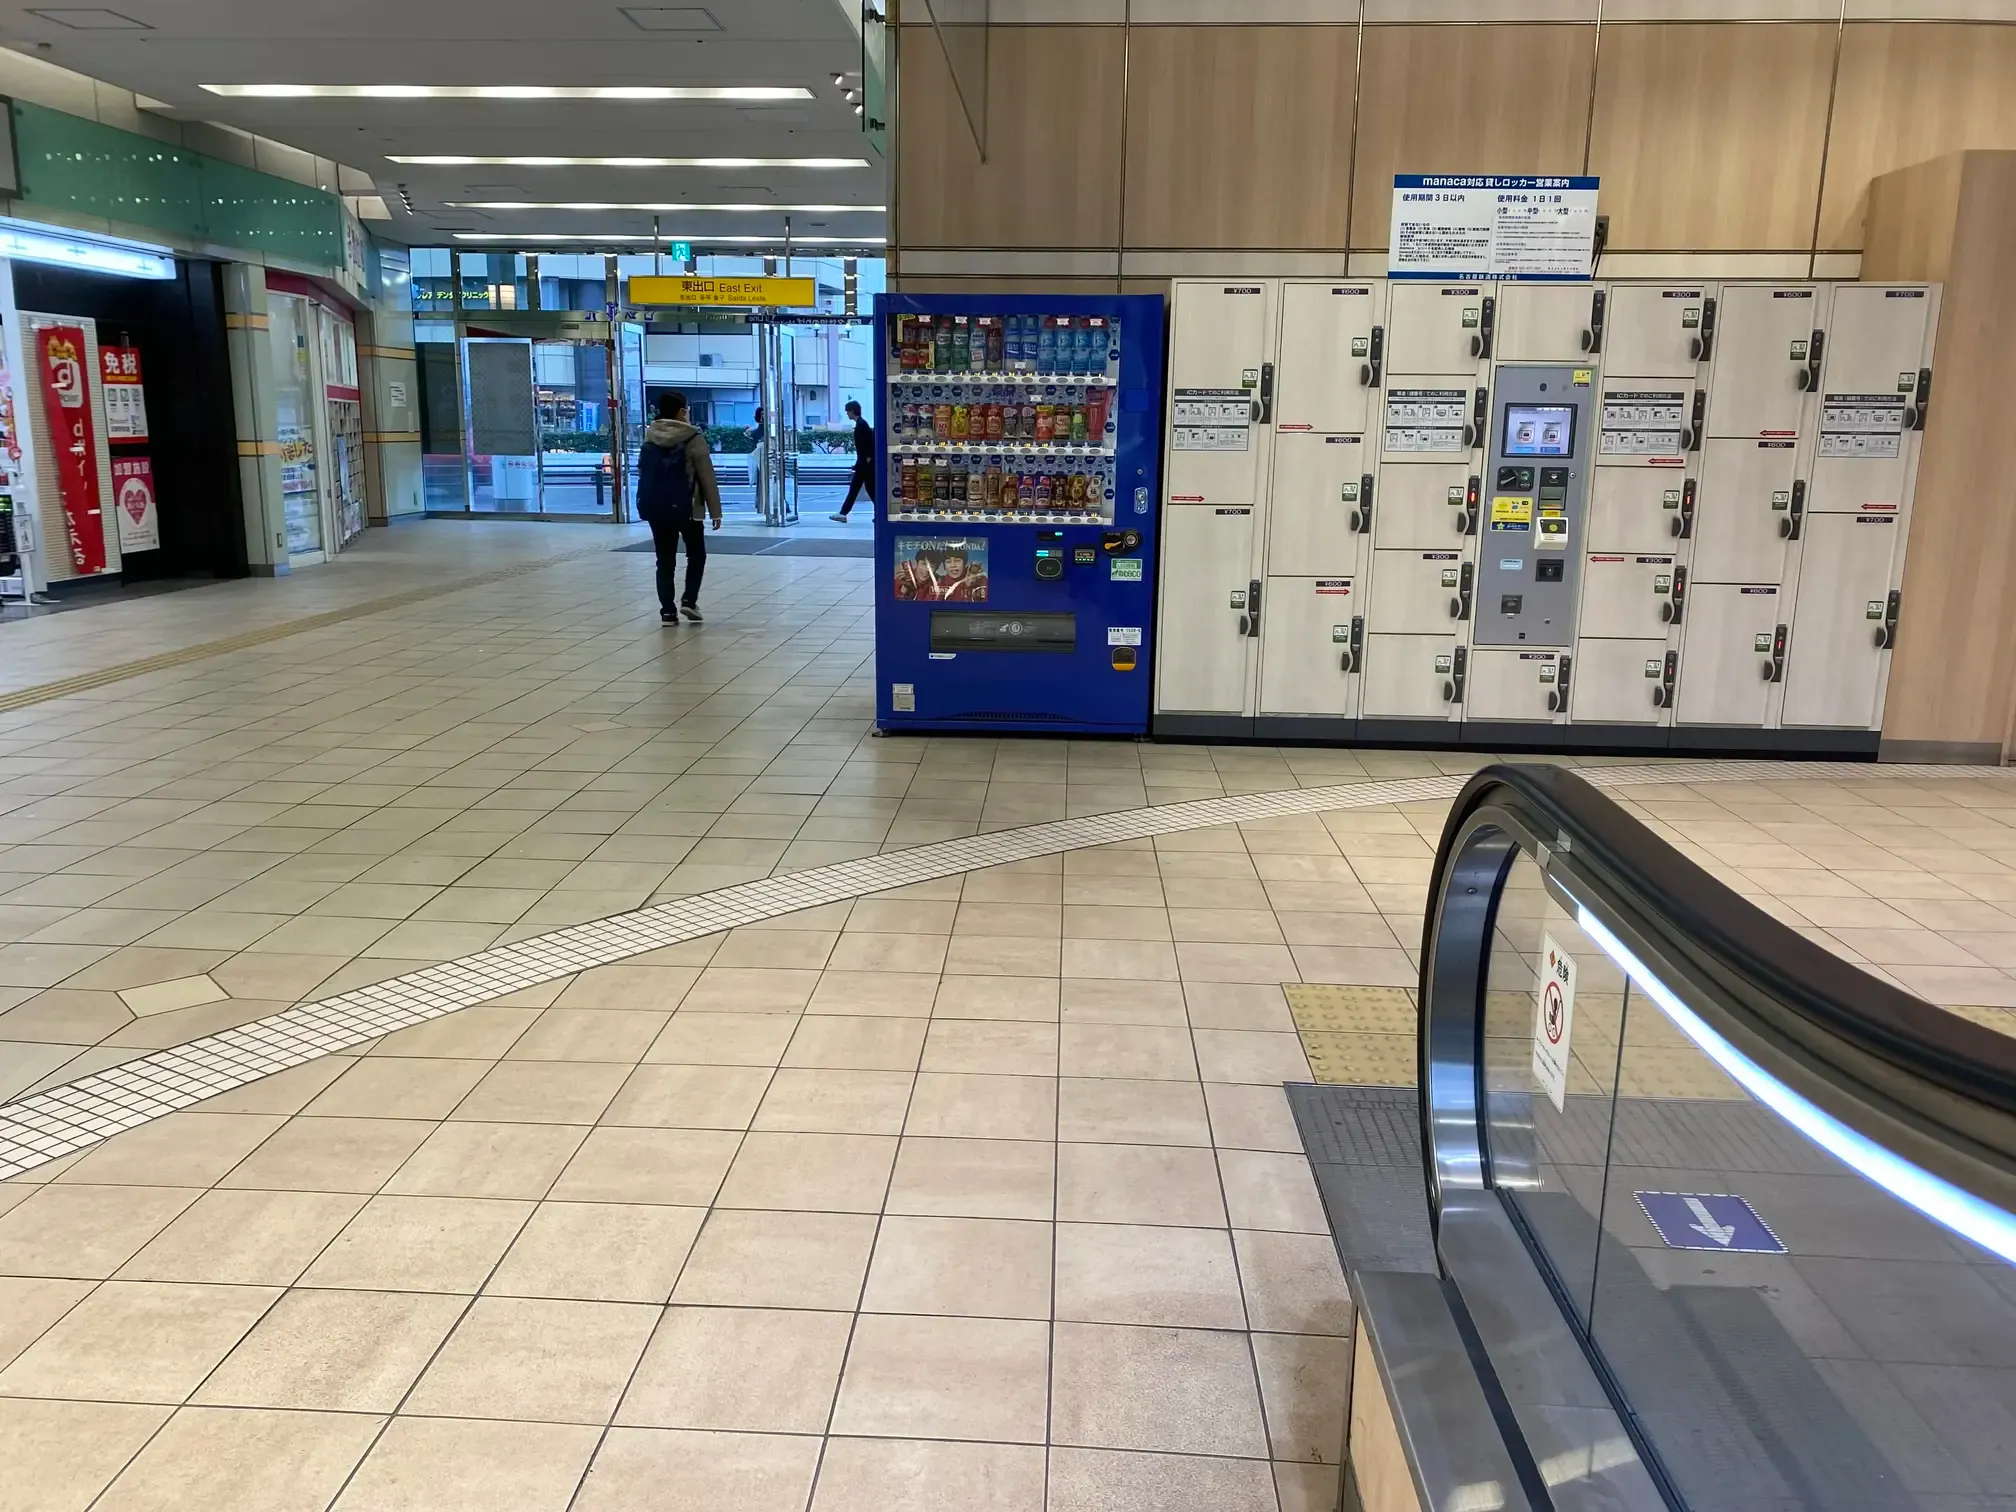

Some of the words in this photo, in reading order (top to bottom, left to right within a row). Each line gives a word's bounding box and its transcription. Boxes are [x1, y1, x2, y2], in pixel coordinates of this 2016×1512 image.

[1497, 194, 1528, 203] 使用料金
[681, 280, 715, 293] 東出口
[719, 282, 741, 293] East
[744, 283, 762, 293] Exit
[103, 351, 138, 375] 免税
